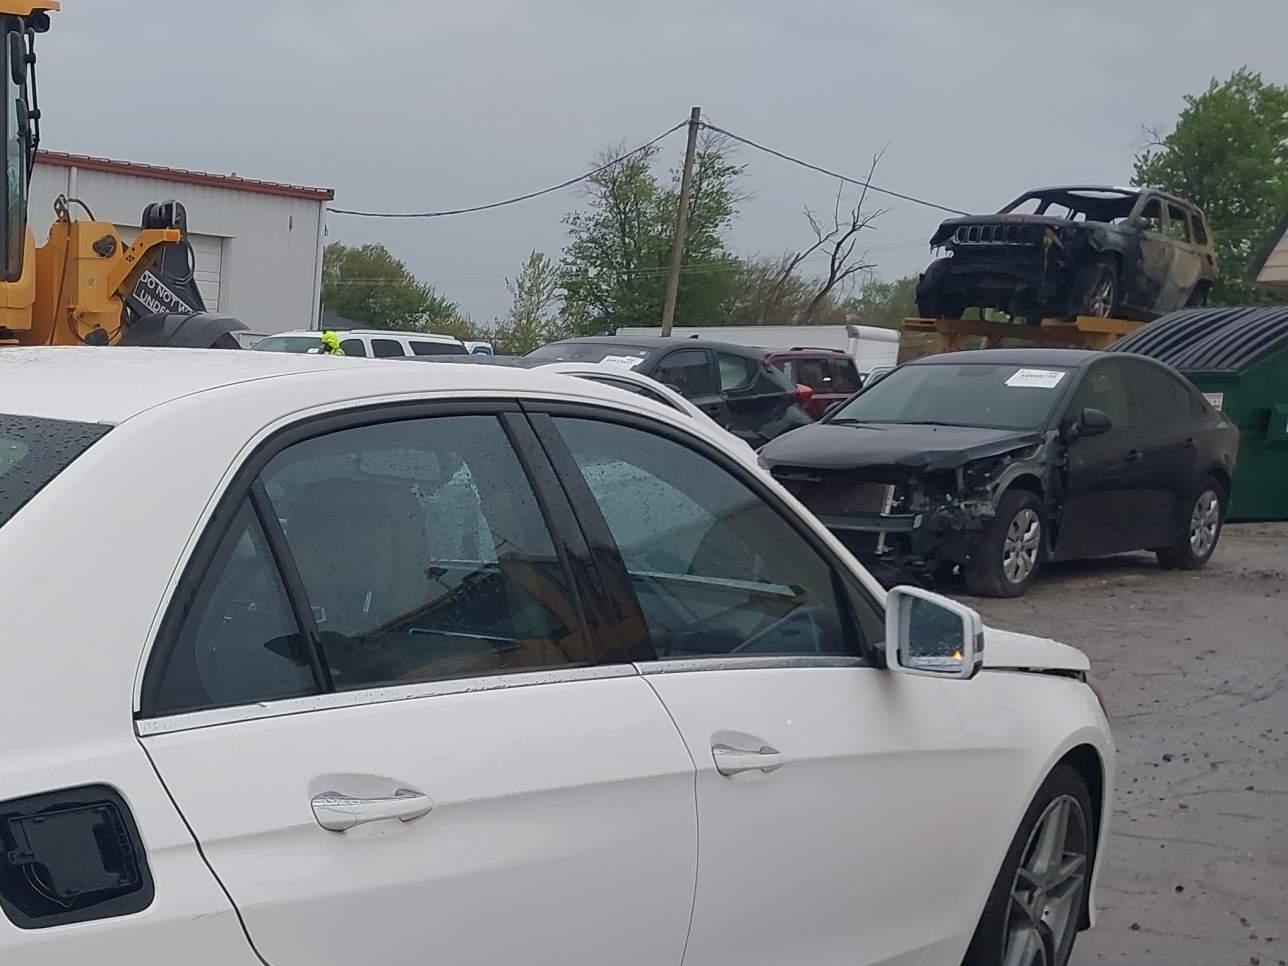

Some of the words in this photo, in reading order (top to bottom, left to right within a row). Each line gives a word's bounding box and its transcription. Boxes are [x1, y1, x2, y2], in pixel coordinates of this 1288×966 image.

[140, 273, 155, 288] DO
[156, 286, 178, 306] NOT
[140, 289, 170, 313] UNDE
